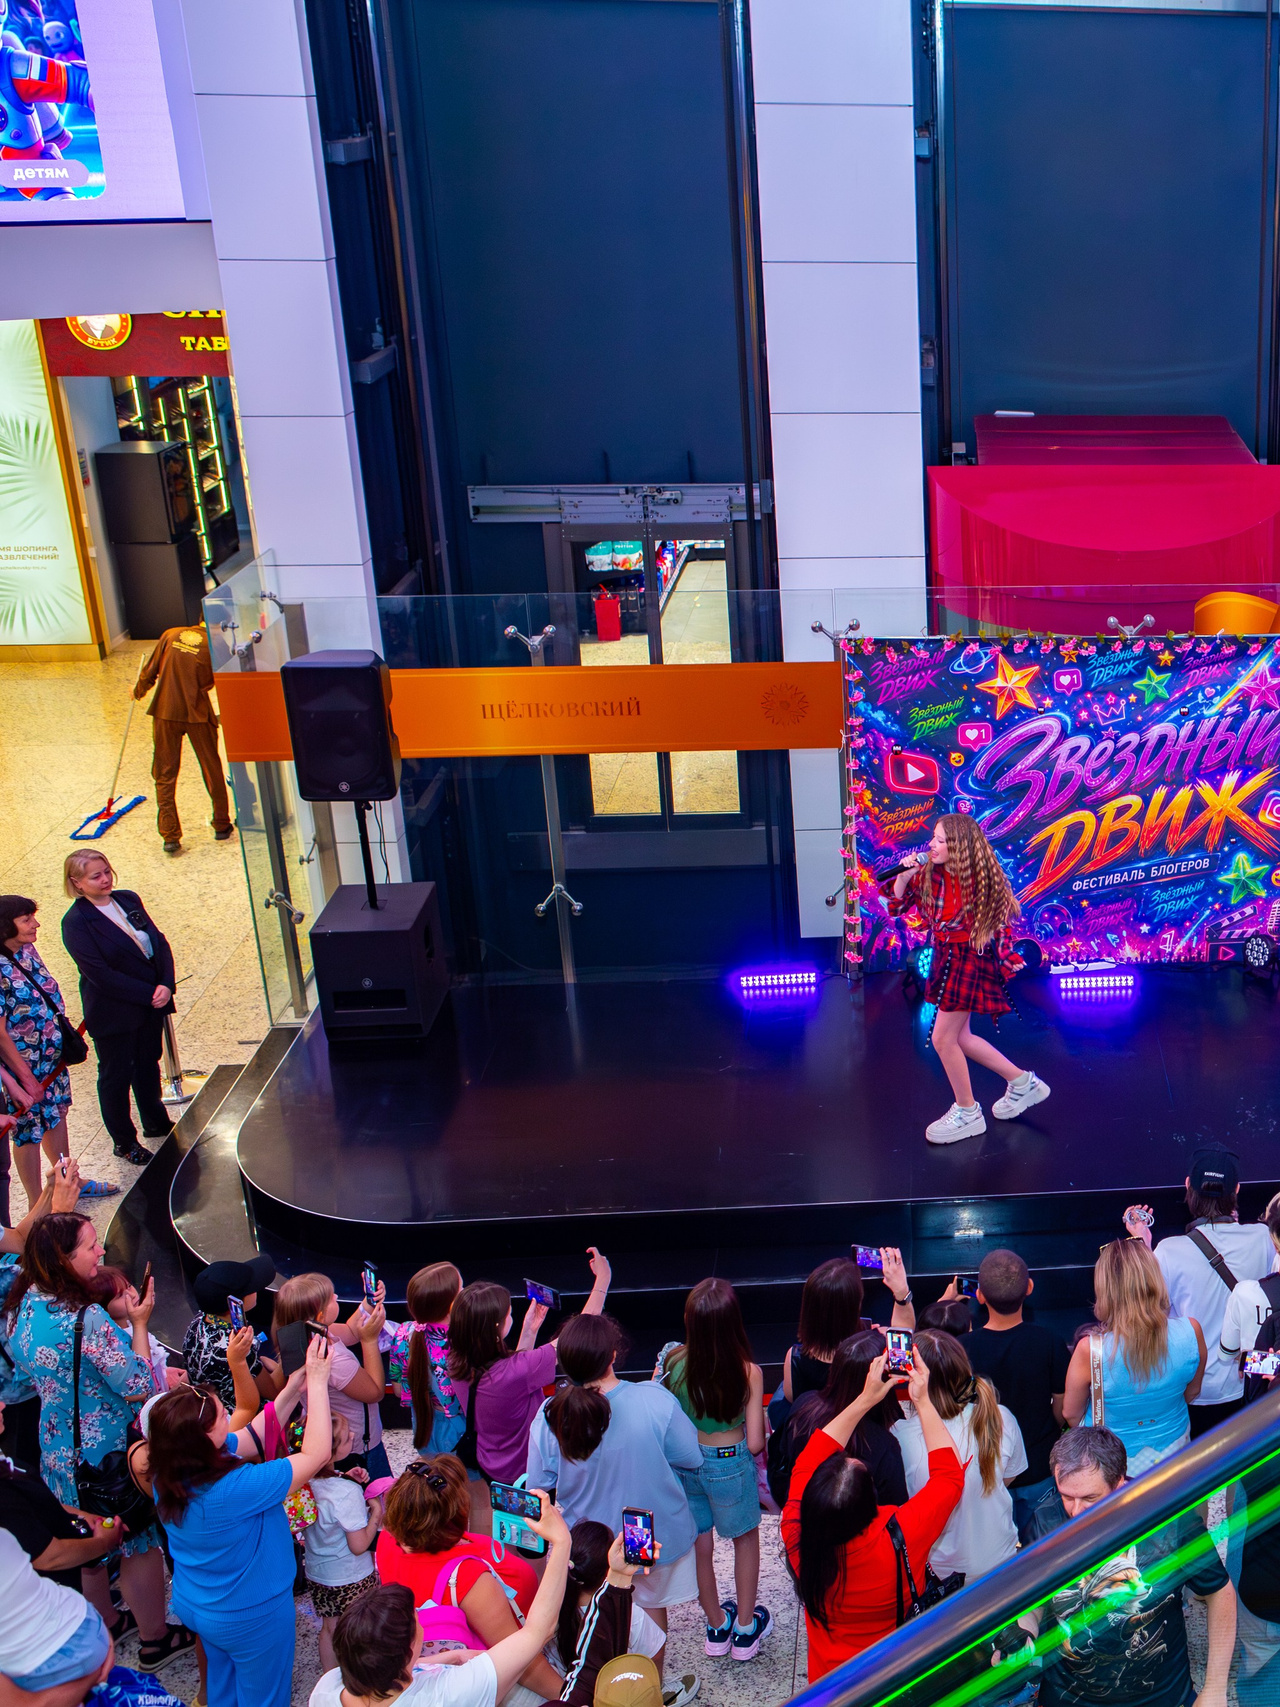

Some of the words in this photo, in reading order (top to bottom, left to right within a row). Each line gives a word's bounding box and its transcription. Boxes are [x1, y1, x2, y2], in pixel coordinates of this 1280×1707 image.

[13, 168, 69, 180] детям
[180, 336, 229, 351] ТАБ
[873, 667, 947, 706] ДВИЖ
[1089, 659, 1147, 688] ДВИЖ
[1183, 660, 1240, 688] ДВИЖ
[481, 697, 643, 720] ЩЁЛКОВСКИЙ
[911, 710, 966, 740] ДВИЖ
[880, 813, 935, 846] ДВИЖ
[1072, 869, 1146, 891] ФЕСТИВАЛЬ
[1150, 858, 1210, 877] БЛОГЕРОВ
[1150, 893, 1207, 922] ДВИЖ
